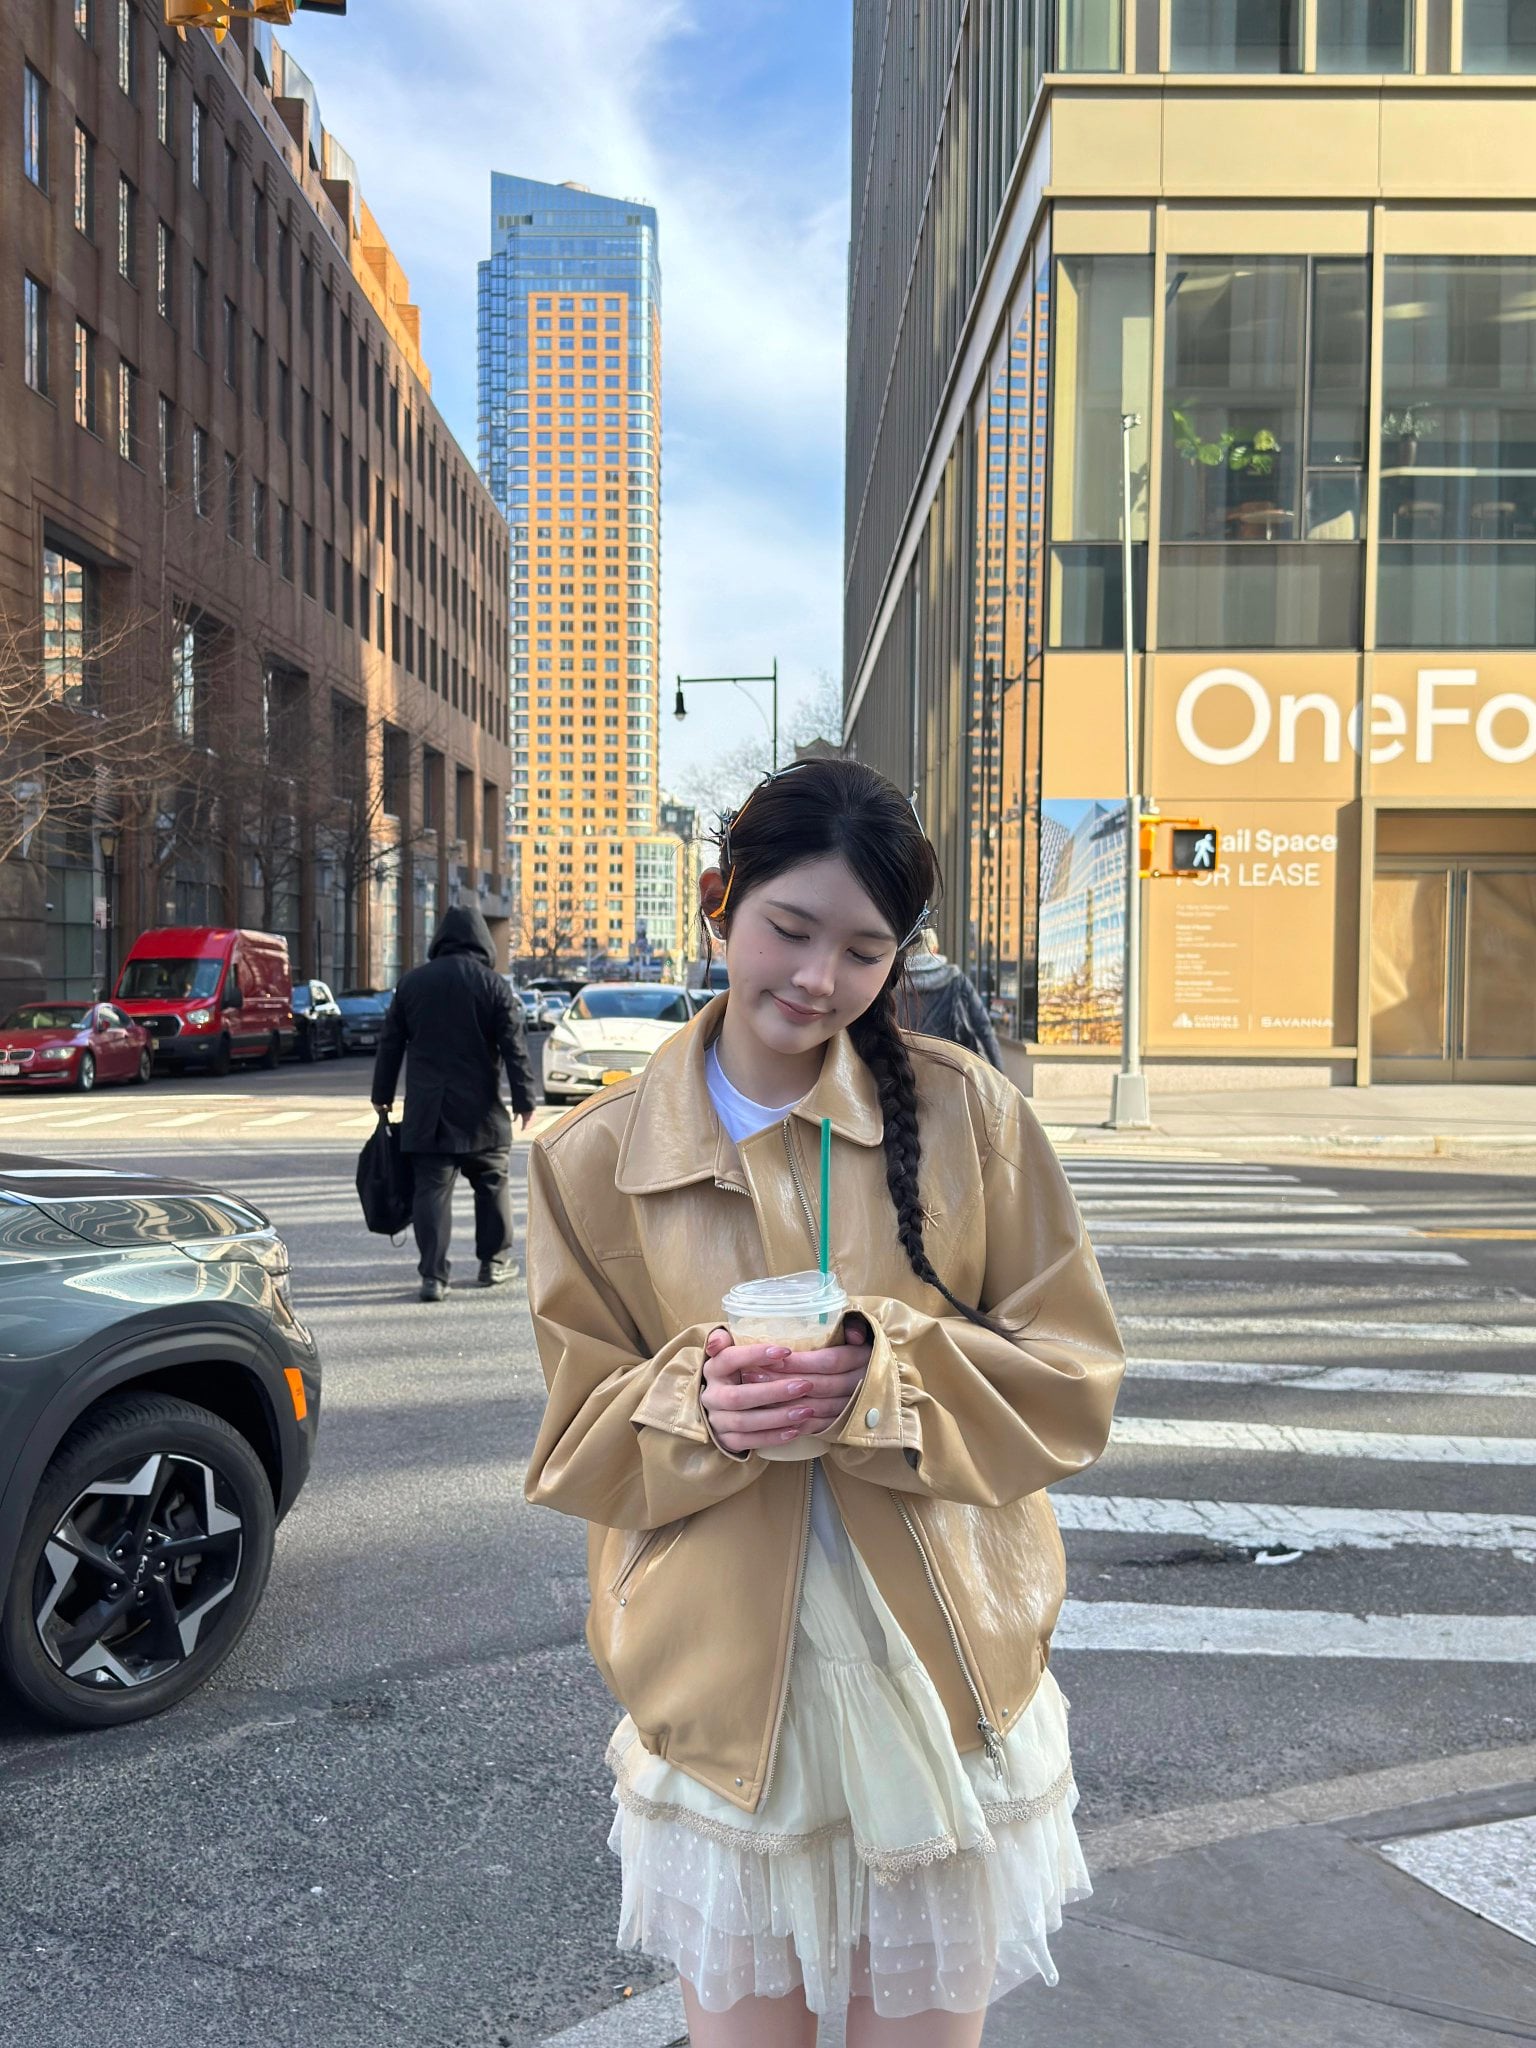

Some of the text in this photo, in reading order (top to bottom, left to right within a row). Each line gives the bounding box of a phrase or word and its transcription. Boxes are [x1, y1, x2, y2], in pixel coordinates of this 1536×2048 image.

[1176, 667, 1536, 766] OneFo
[1222, 828, 1338, 858] ail Space
[1239, 863, 1321, 887] LEASE
[1260, 1015, 1334, 1028] SAVANNA
